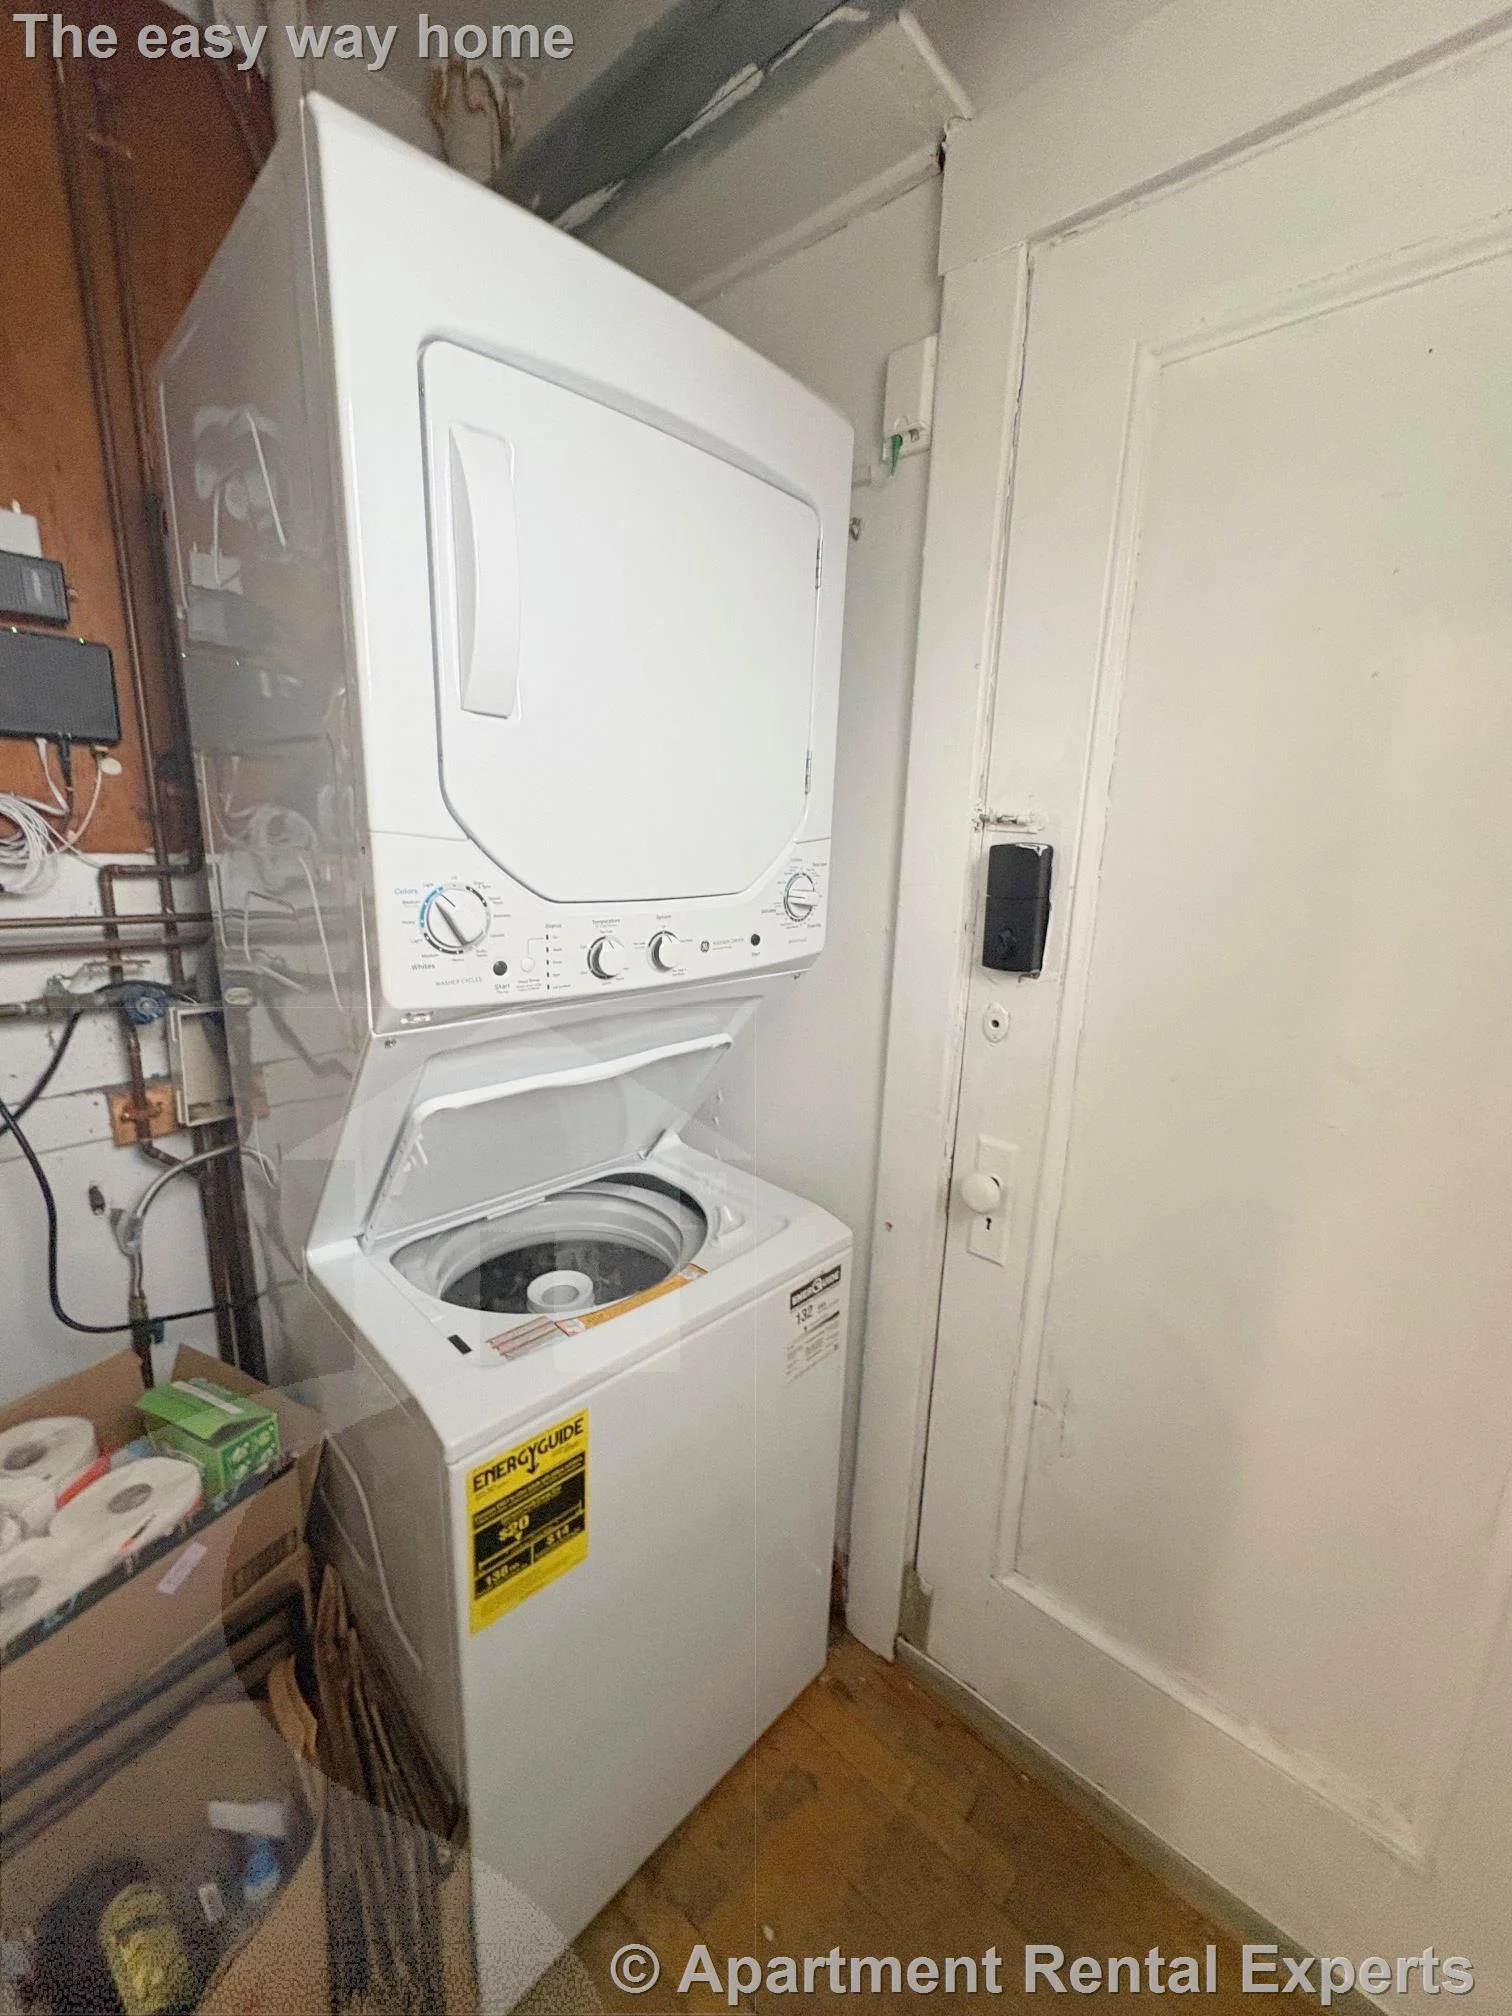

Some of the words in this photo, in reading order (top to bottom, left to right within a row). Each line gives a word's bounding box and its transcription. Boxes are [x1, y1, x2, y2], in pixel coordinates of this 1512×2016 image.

[394, 887, 418, 896] Colors
[411, 963, 436, 971] Whites
[494, 983, 511, 991] Start
[473, 1416, 585, 1492] ENERGYGUIDE
